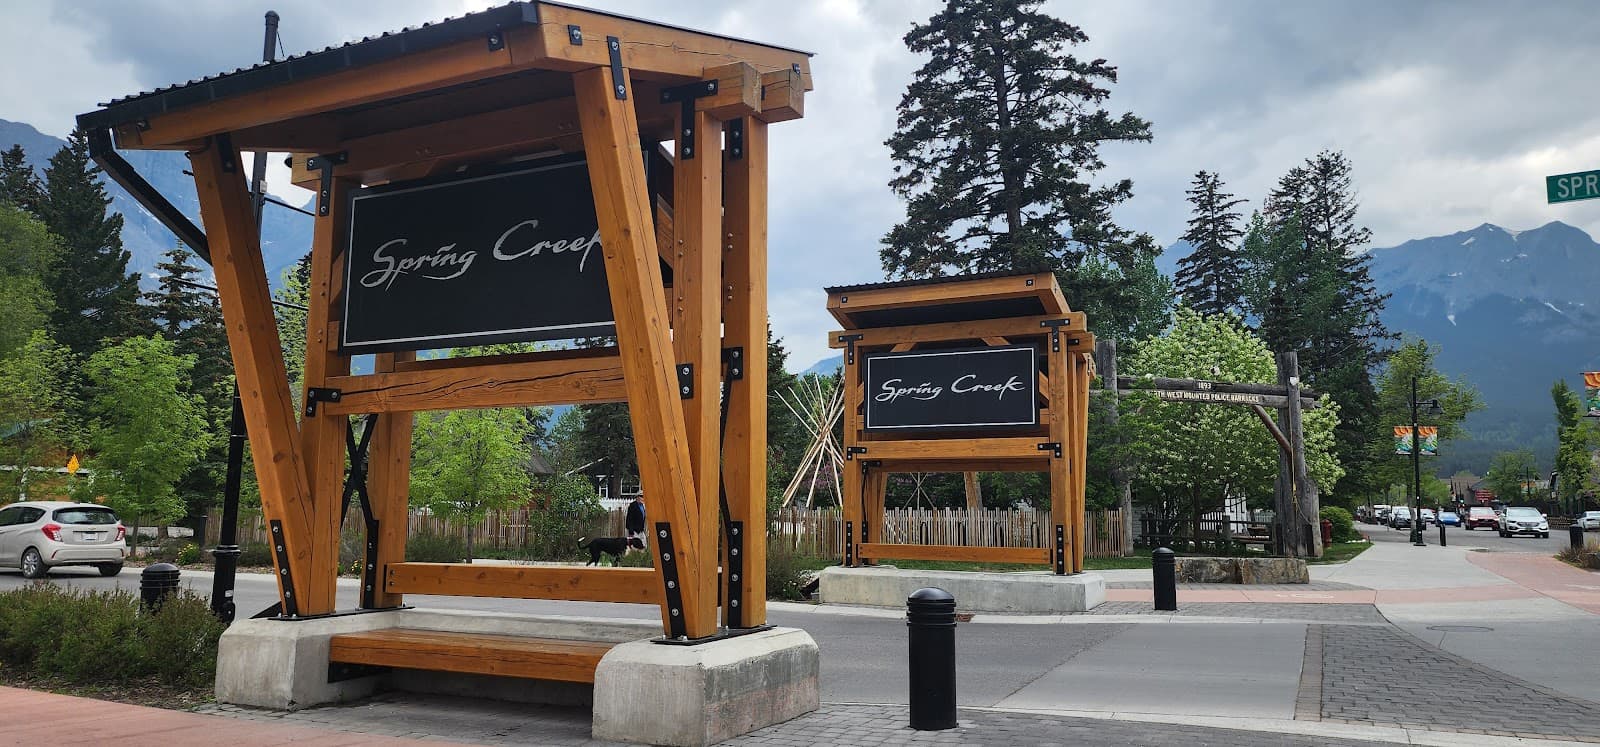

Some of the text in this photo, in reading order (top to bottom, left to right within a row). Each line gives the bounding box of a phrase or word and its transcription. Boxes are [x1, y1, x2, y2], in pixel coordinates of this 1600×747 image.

[1557, 174, 1599, 198] SPR
[359, 238, 478, 292] Spring
[874, 374, 1026, 404] Spring Creek
[1166, 391, 1183, 399] WEST
[1184, 392, 1210, 400] MOUNTED
[1211, 393, 1230, 401] POLICE
